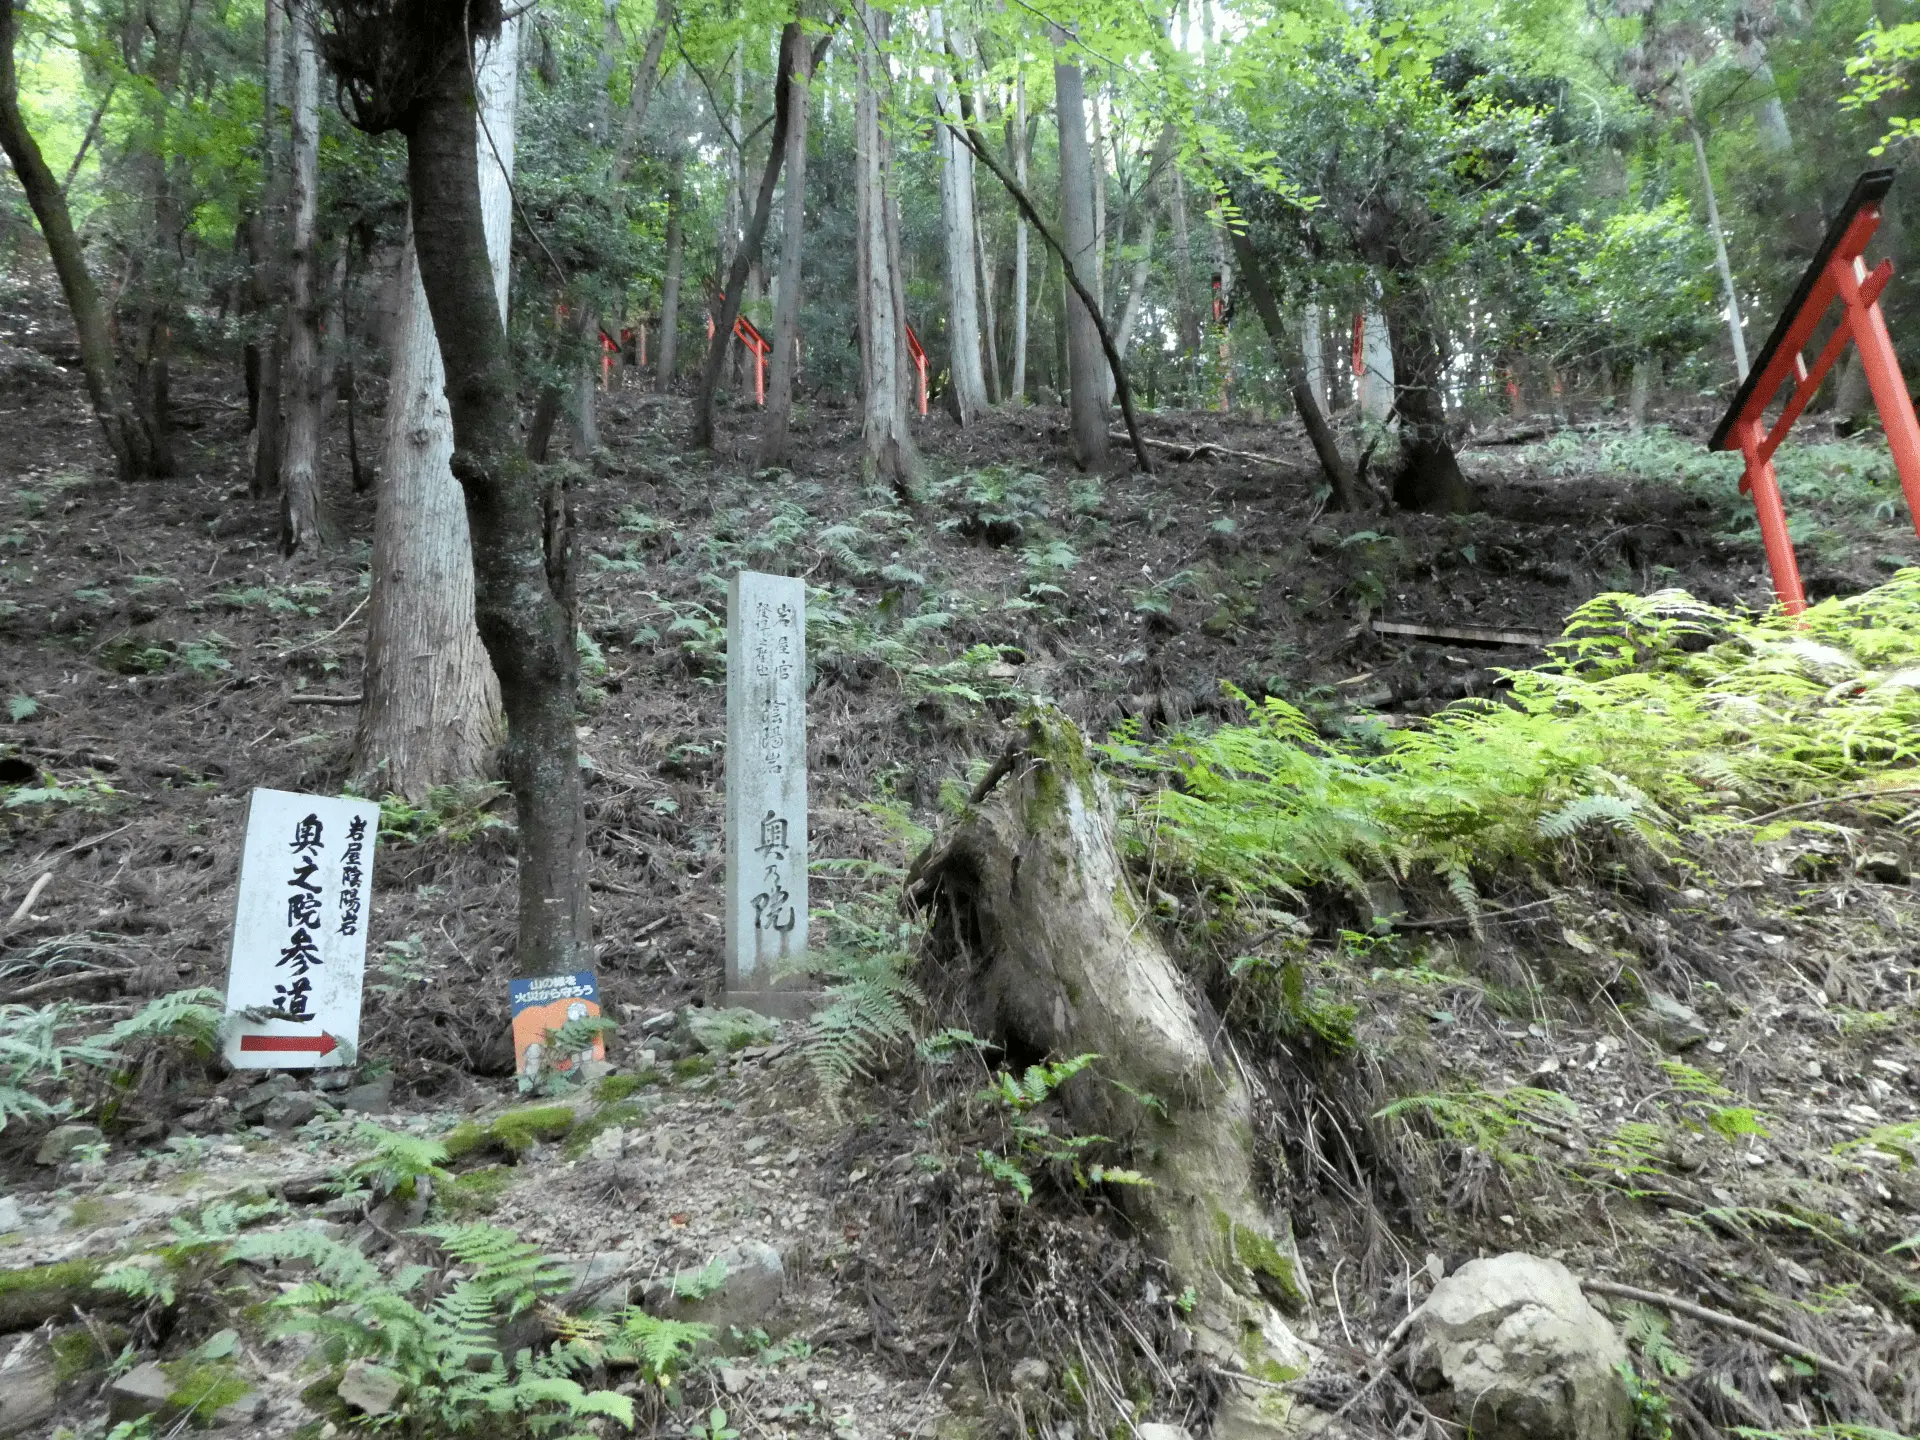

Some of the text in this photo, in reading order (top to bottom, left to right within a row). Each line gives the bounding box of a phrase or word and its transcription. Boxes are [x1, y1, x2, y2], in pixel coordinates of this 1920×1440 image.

[272, 813, 326, 1022] 奥之院参道
[514, 984, 594, 1004] 火災から守ろう
